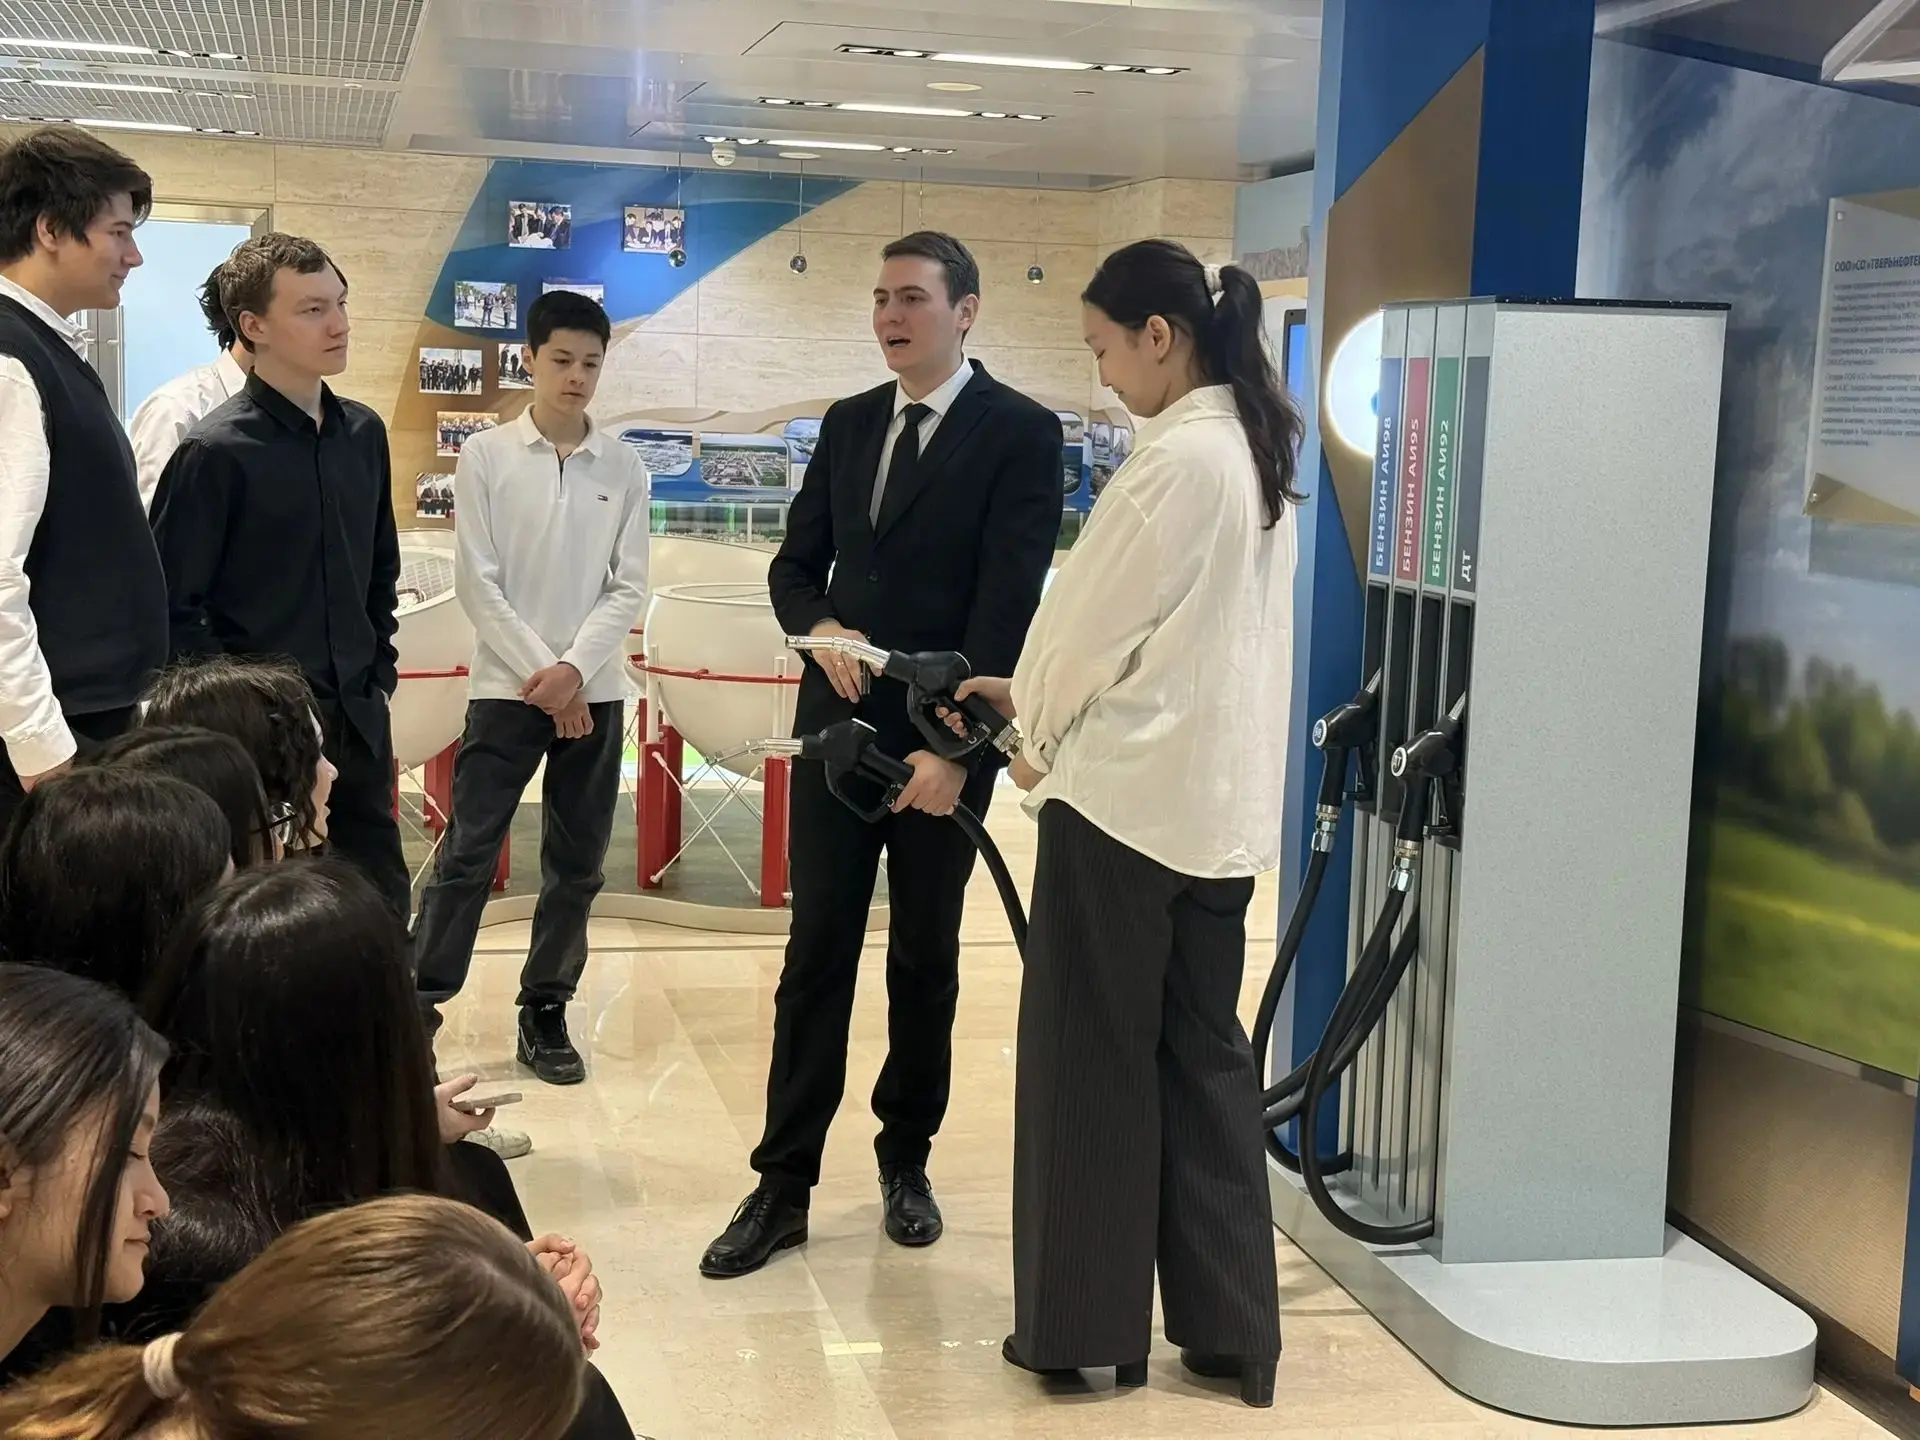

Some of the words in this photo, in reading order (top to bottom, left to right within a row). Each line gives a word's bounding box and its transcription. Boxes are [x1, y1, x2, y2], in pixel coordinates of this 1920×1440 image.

[1381, 417, 1391, 474] АИ98
[1438, 420, 1449, 481] АИ92
[1376, 481, 1388, 567] БЕНЗИН
[1403, 484, 1414, 572] БЕНЗИН
[1409, 419, 1419, 477] АИ95
[1432, 487, 1445, 578] БЕНЗИН
[1461, 550, 1471, 583] ДТ
